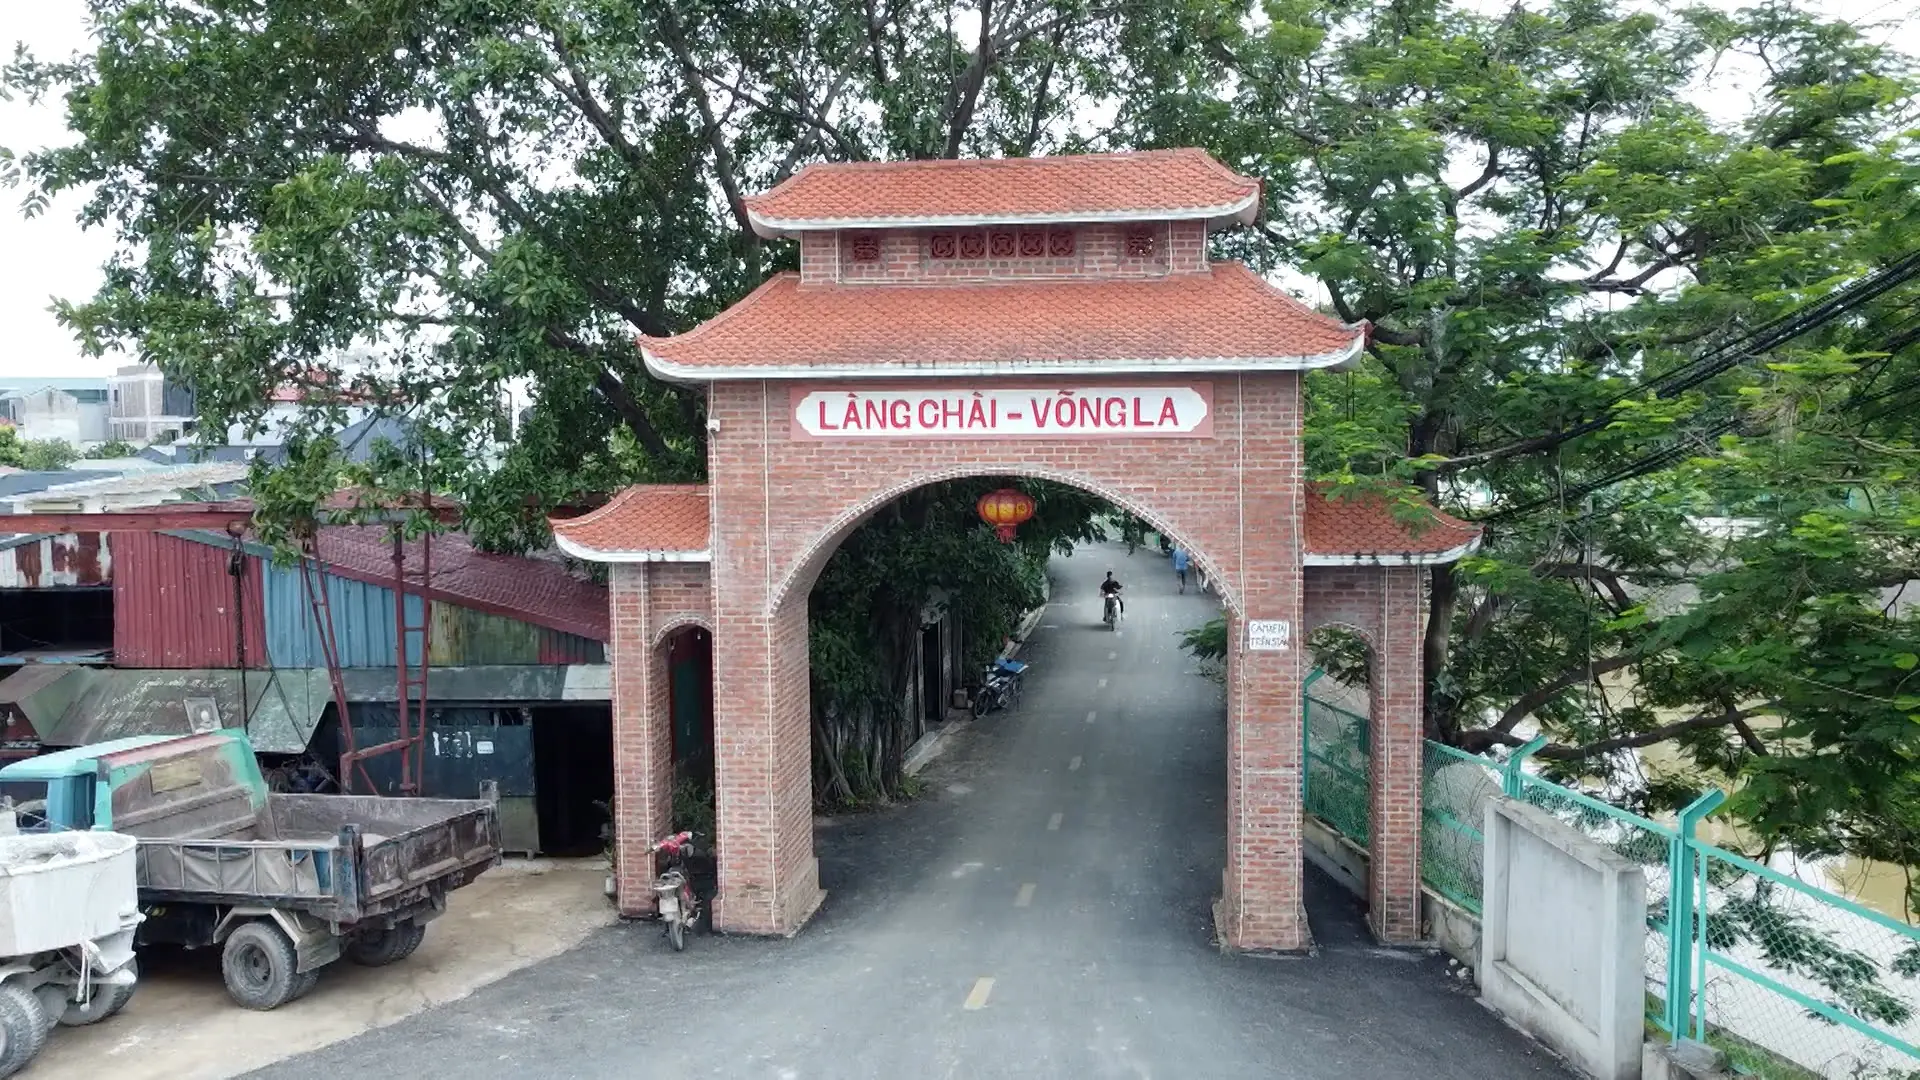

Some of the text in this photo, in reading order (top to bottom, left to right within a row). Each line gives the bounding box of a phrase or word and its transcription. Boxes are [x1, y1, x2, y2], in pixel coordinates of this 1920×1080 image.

[818, 391, 911, 430] LÀNG
[917, 390, 997, 429] CHÀI
[1030, 390, 1127, 428] VÕNG
[1133, 396, 1179, 427] LA
